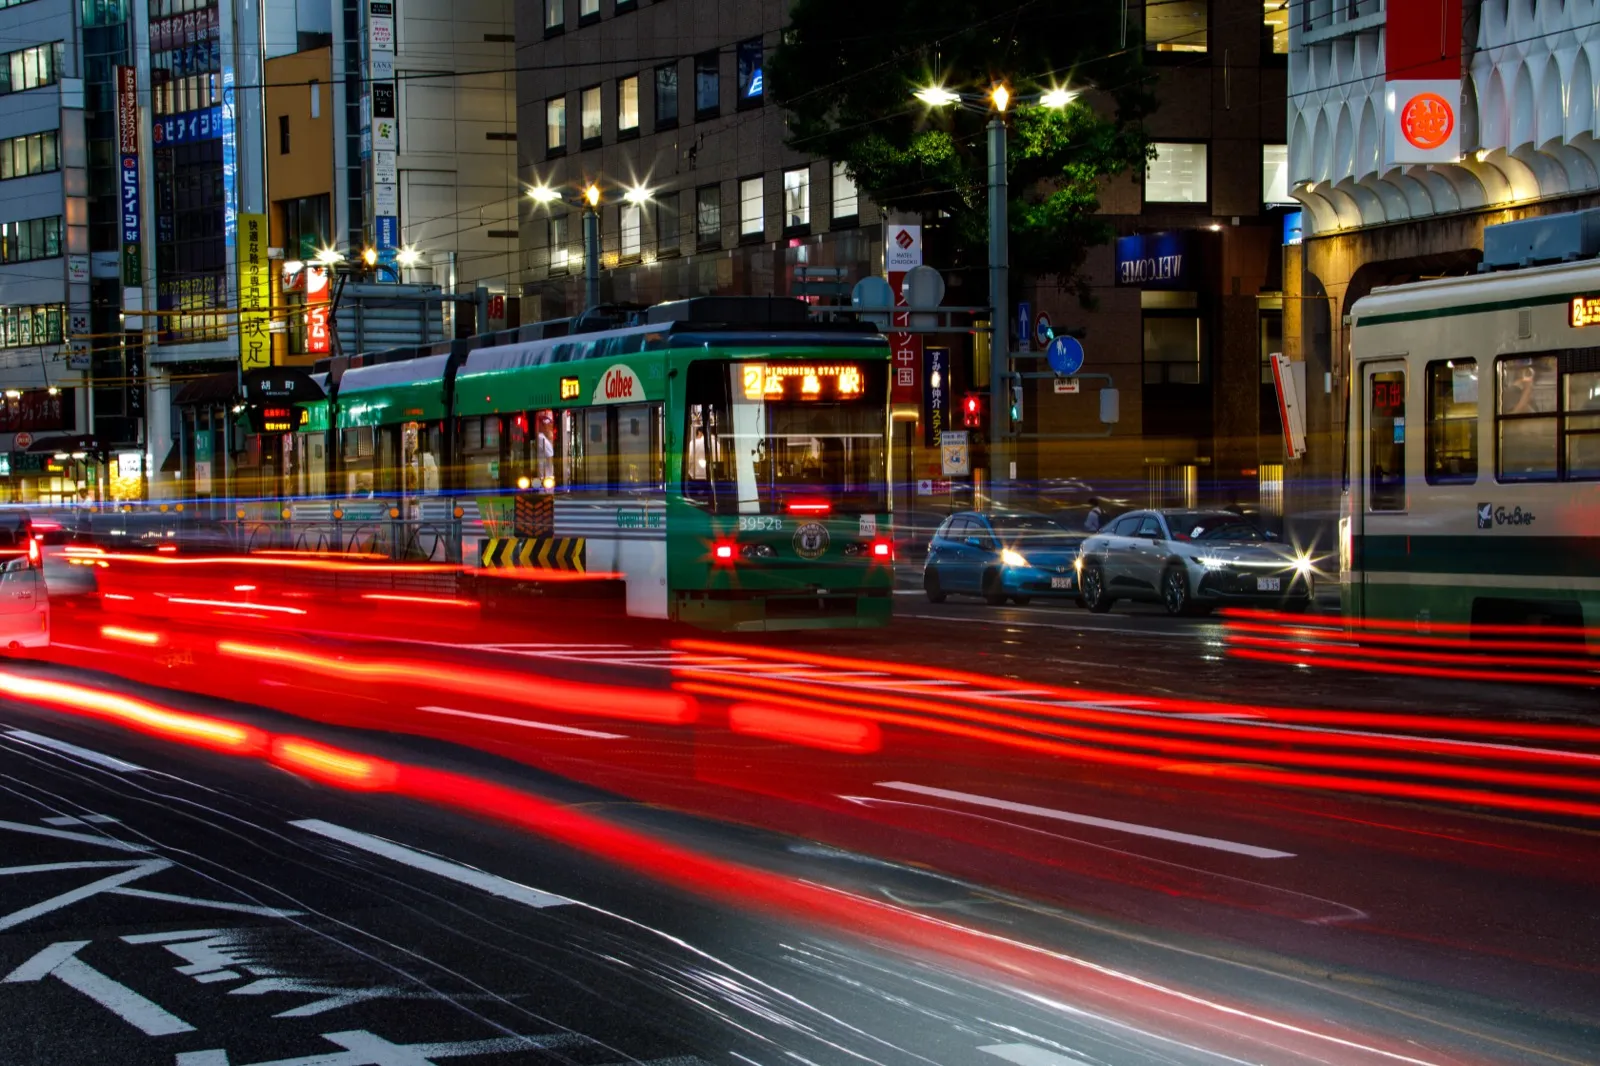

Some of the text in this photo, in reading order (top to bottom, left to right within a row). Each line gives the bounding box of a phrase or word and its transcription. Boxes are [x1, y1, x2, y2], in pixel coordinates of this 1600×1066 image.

[127, 69, 136, 153] かわさきダンススクール
[211, 113, 221, 132] 5F
[126, 231, 137, 241] 5F
[248, 219, 259, 309] 快適な靴の専門店
[605, 370, 633, 399] Calbee
[764, 366, 857, 376] HIROSHIMA STATION
[931, 351, 942, 447] すみ仲介ステップ
